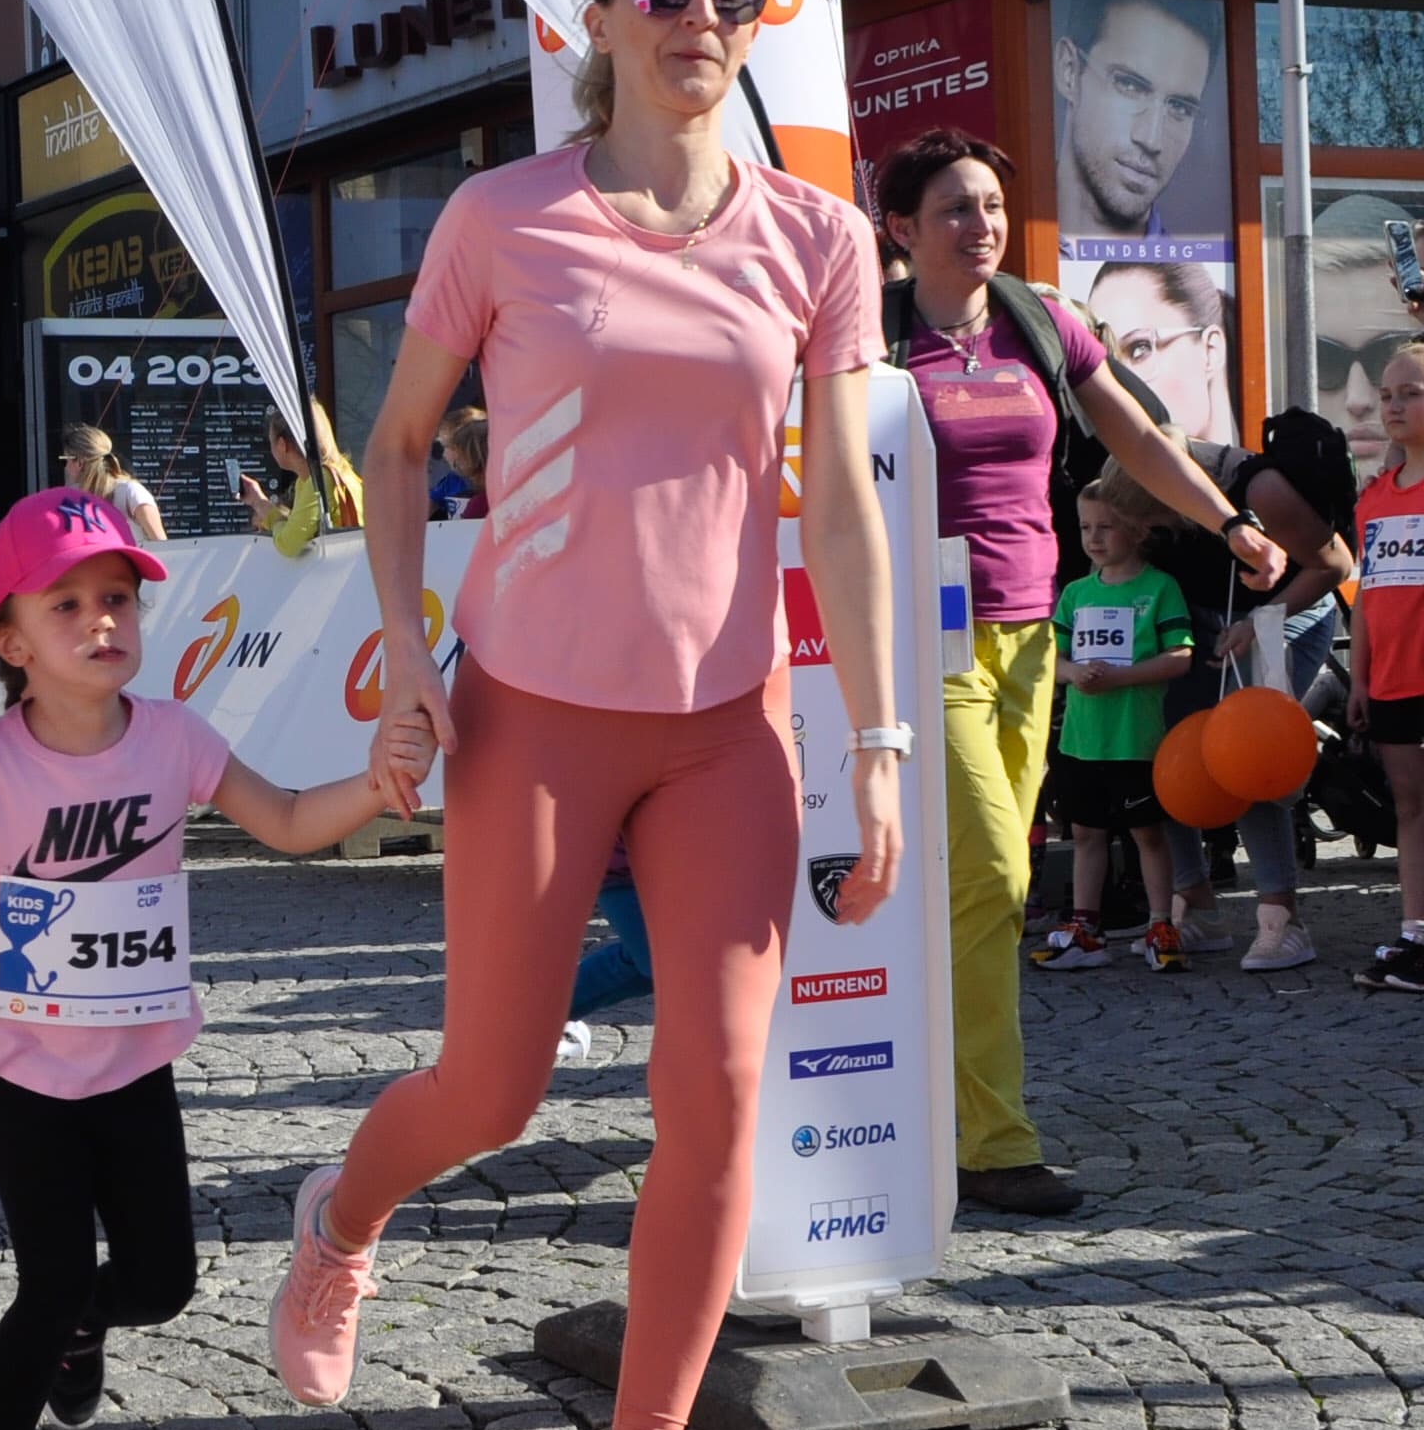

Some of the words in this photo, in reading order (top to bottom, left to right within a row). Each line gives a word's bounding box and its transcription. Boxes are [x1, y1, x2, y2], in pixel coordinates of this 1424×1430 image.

[874, 38, 940, 66] OPTIKA
[853, 61, 989, 117] UNETTES
[1080, 244, 1193, 258] LINDBERG
[68, 355, 135, 386] 04
[872, 453, 895, 481] N
[1377, 539, 1424, 559] 3042
[227, 632, 285, 668] NN
[795, 637, 826, 658] AV
[1077, 629, 1125, 647] 3156
[34, 794, 152, 864] NIKE
[137, 883, 163, 896] KIDS
[137, 896, 160, 908] CUP
[7, 895, 44, 911] KIDS
[7, 912, 40, 925] CUP
[68, 926, 177, 969] 3154
[797, 974, 883, 998] NUTREND
[825, 1123, 896, 1149] ŠKODA
[807, 1211, 886, 1242] KPMG
